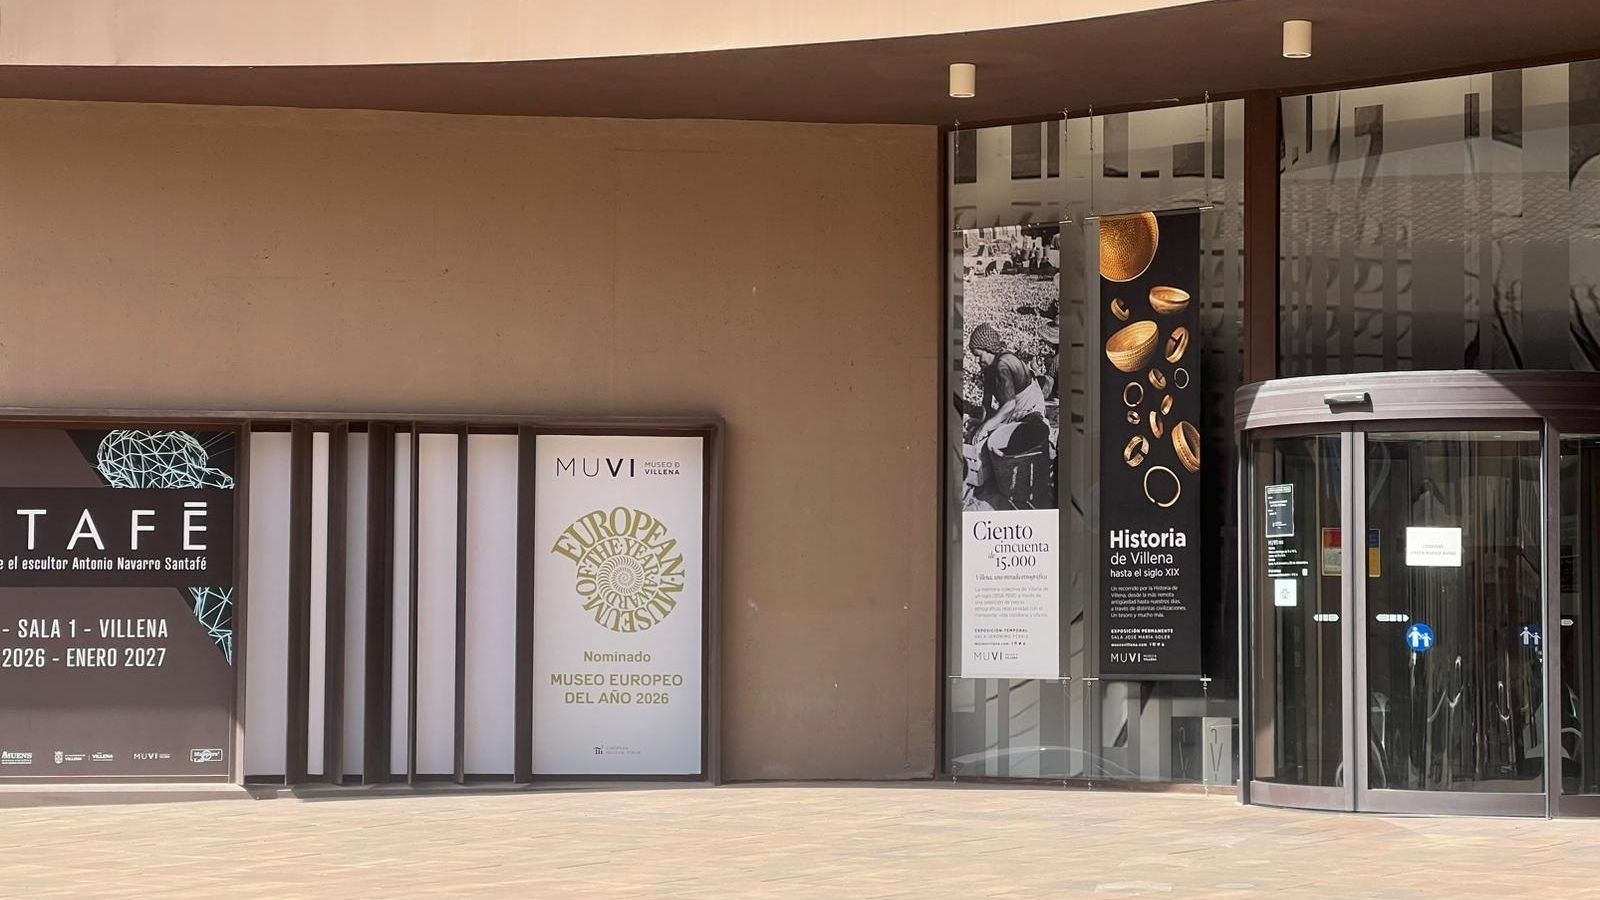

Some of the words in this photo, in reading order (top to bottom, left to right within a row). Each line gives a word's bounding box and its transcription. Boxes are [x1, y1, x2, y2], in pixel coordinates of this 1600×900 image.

[557, 458, 634, 477] MUVI
[973, 521, 1032, 540] Ciento
[1110, 528, 1186, 548] Historia
[551, 507, 685, 577] EUROPEAN
[995, 540, 1049, 553] cincuenta
[583, 538, 622, 568] THE
[624, 538, 660, 576] YEAR
[996, 555, 1036, 570] 15.000
[1110, 552, 1127, 565] de
[1130, 551, 1173, 564] Villena
[8, 556, 17, 570] el
[22, 556, 68, 570] escultor
[72, 557, 113, 570] Antonio
[117, 557, 160, 570] Navarro
[165, 556, 206, 570] Santafé
[576, 565, 597, 596] OF
[1110, 568, 1132, 577] hasta
[1134, 568, 1141, 577] el
[1143, 568, 1163, 578] siglo
[1165, 568, 1180, 576] XIX
[606, 576, 658, 609] AWARD
[583, 578, 684, 632] MUSEUM
[18, 619, 60, 638] SALA
[69, 619, 76, 638] 1
[100, 619, 168, 638] VILLENA
[2, 648, 45, 667] 2026
[67, 648, 117, 667] ENERO
[124, 648, 166, 667] 2027
[584, 651, 650, 662] Nominado
[974, 652, 1002, 660] MUVI
[1111, 653, 1140, 662] MUVI
[551, 674, 604, 686] MUSEO
[610, 674, 683, 686] EUROPEO
[565, 692, 594, 704] DEL
[598, 690, 632, 704] AÑO
[636, 693, 669, 704] 2026
